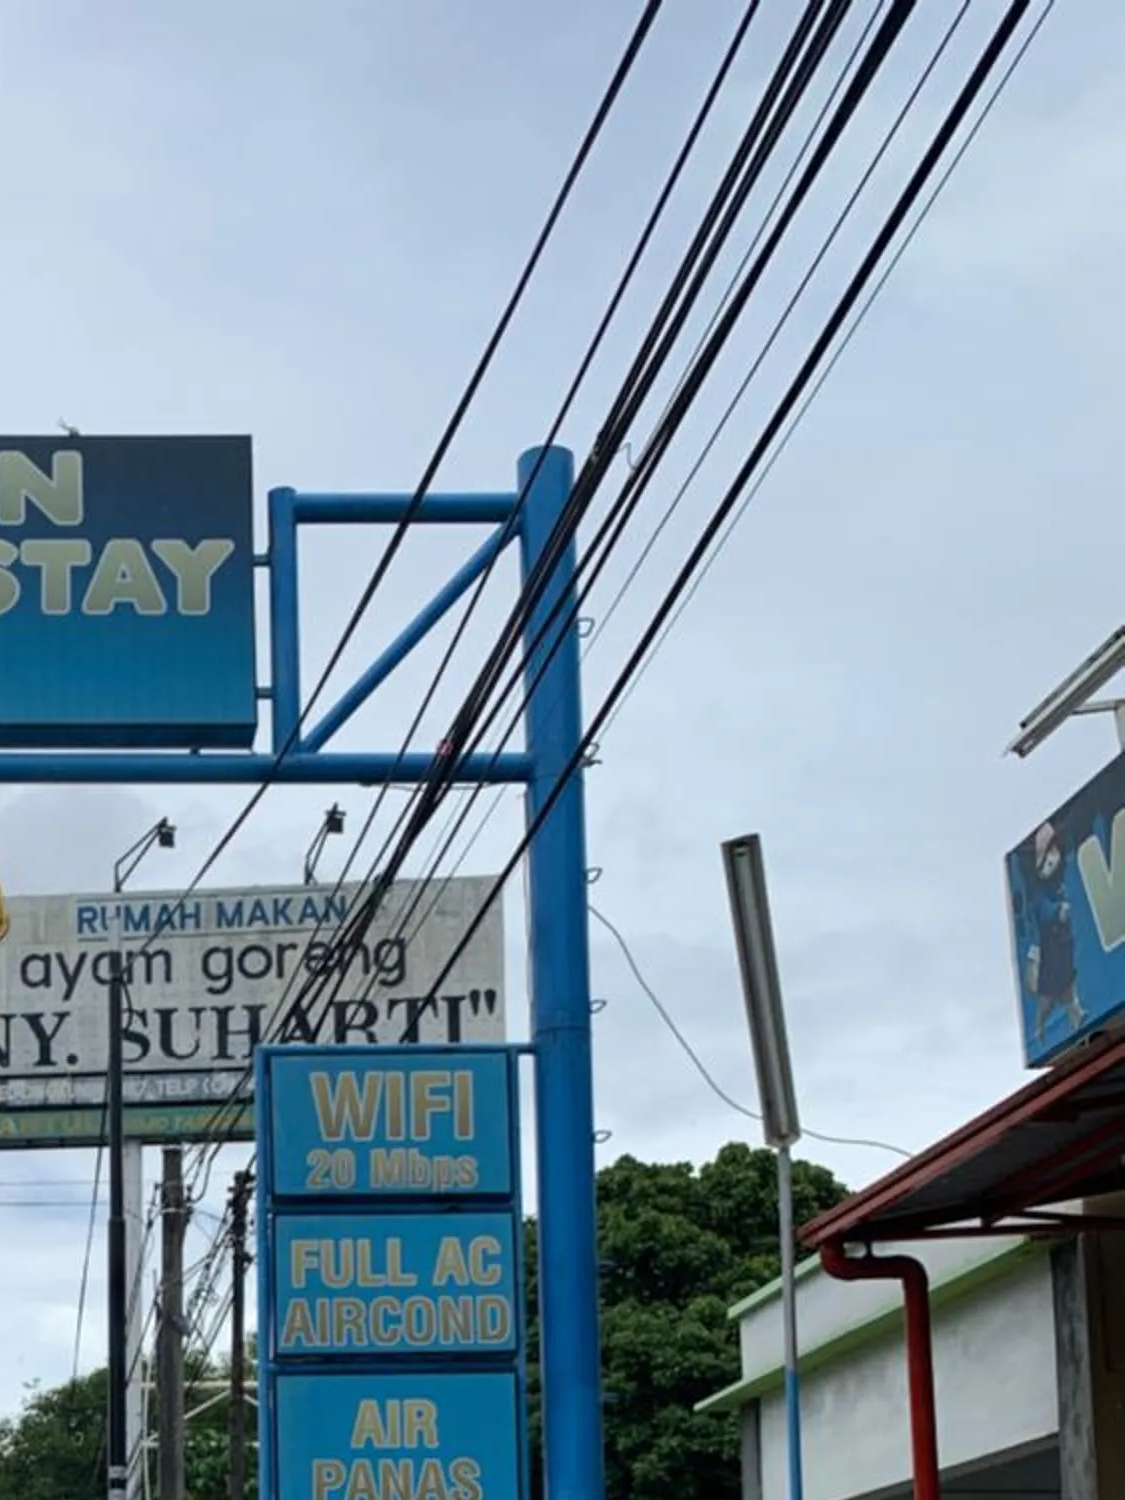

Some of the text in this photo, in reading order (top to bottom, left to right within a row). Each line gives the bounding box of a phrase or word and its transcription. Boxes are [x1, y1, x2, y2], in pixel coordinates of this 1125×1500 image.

[78, 895, 348, 934] RUMAH MAKAN
[21, 937, 408, 1001] ayam goreng
[309, 1070, 474, 1142] WIFI
[306, 1148, 479, 1193] 20 Mbps
[290, 1235, 503, 1288] FULL AC
[280, 1295, 509, 1347] AIRCOND
[350, 1398, 440, 1449] AIR
